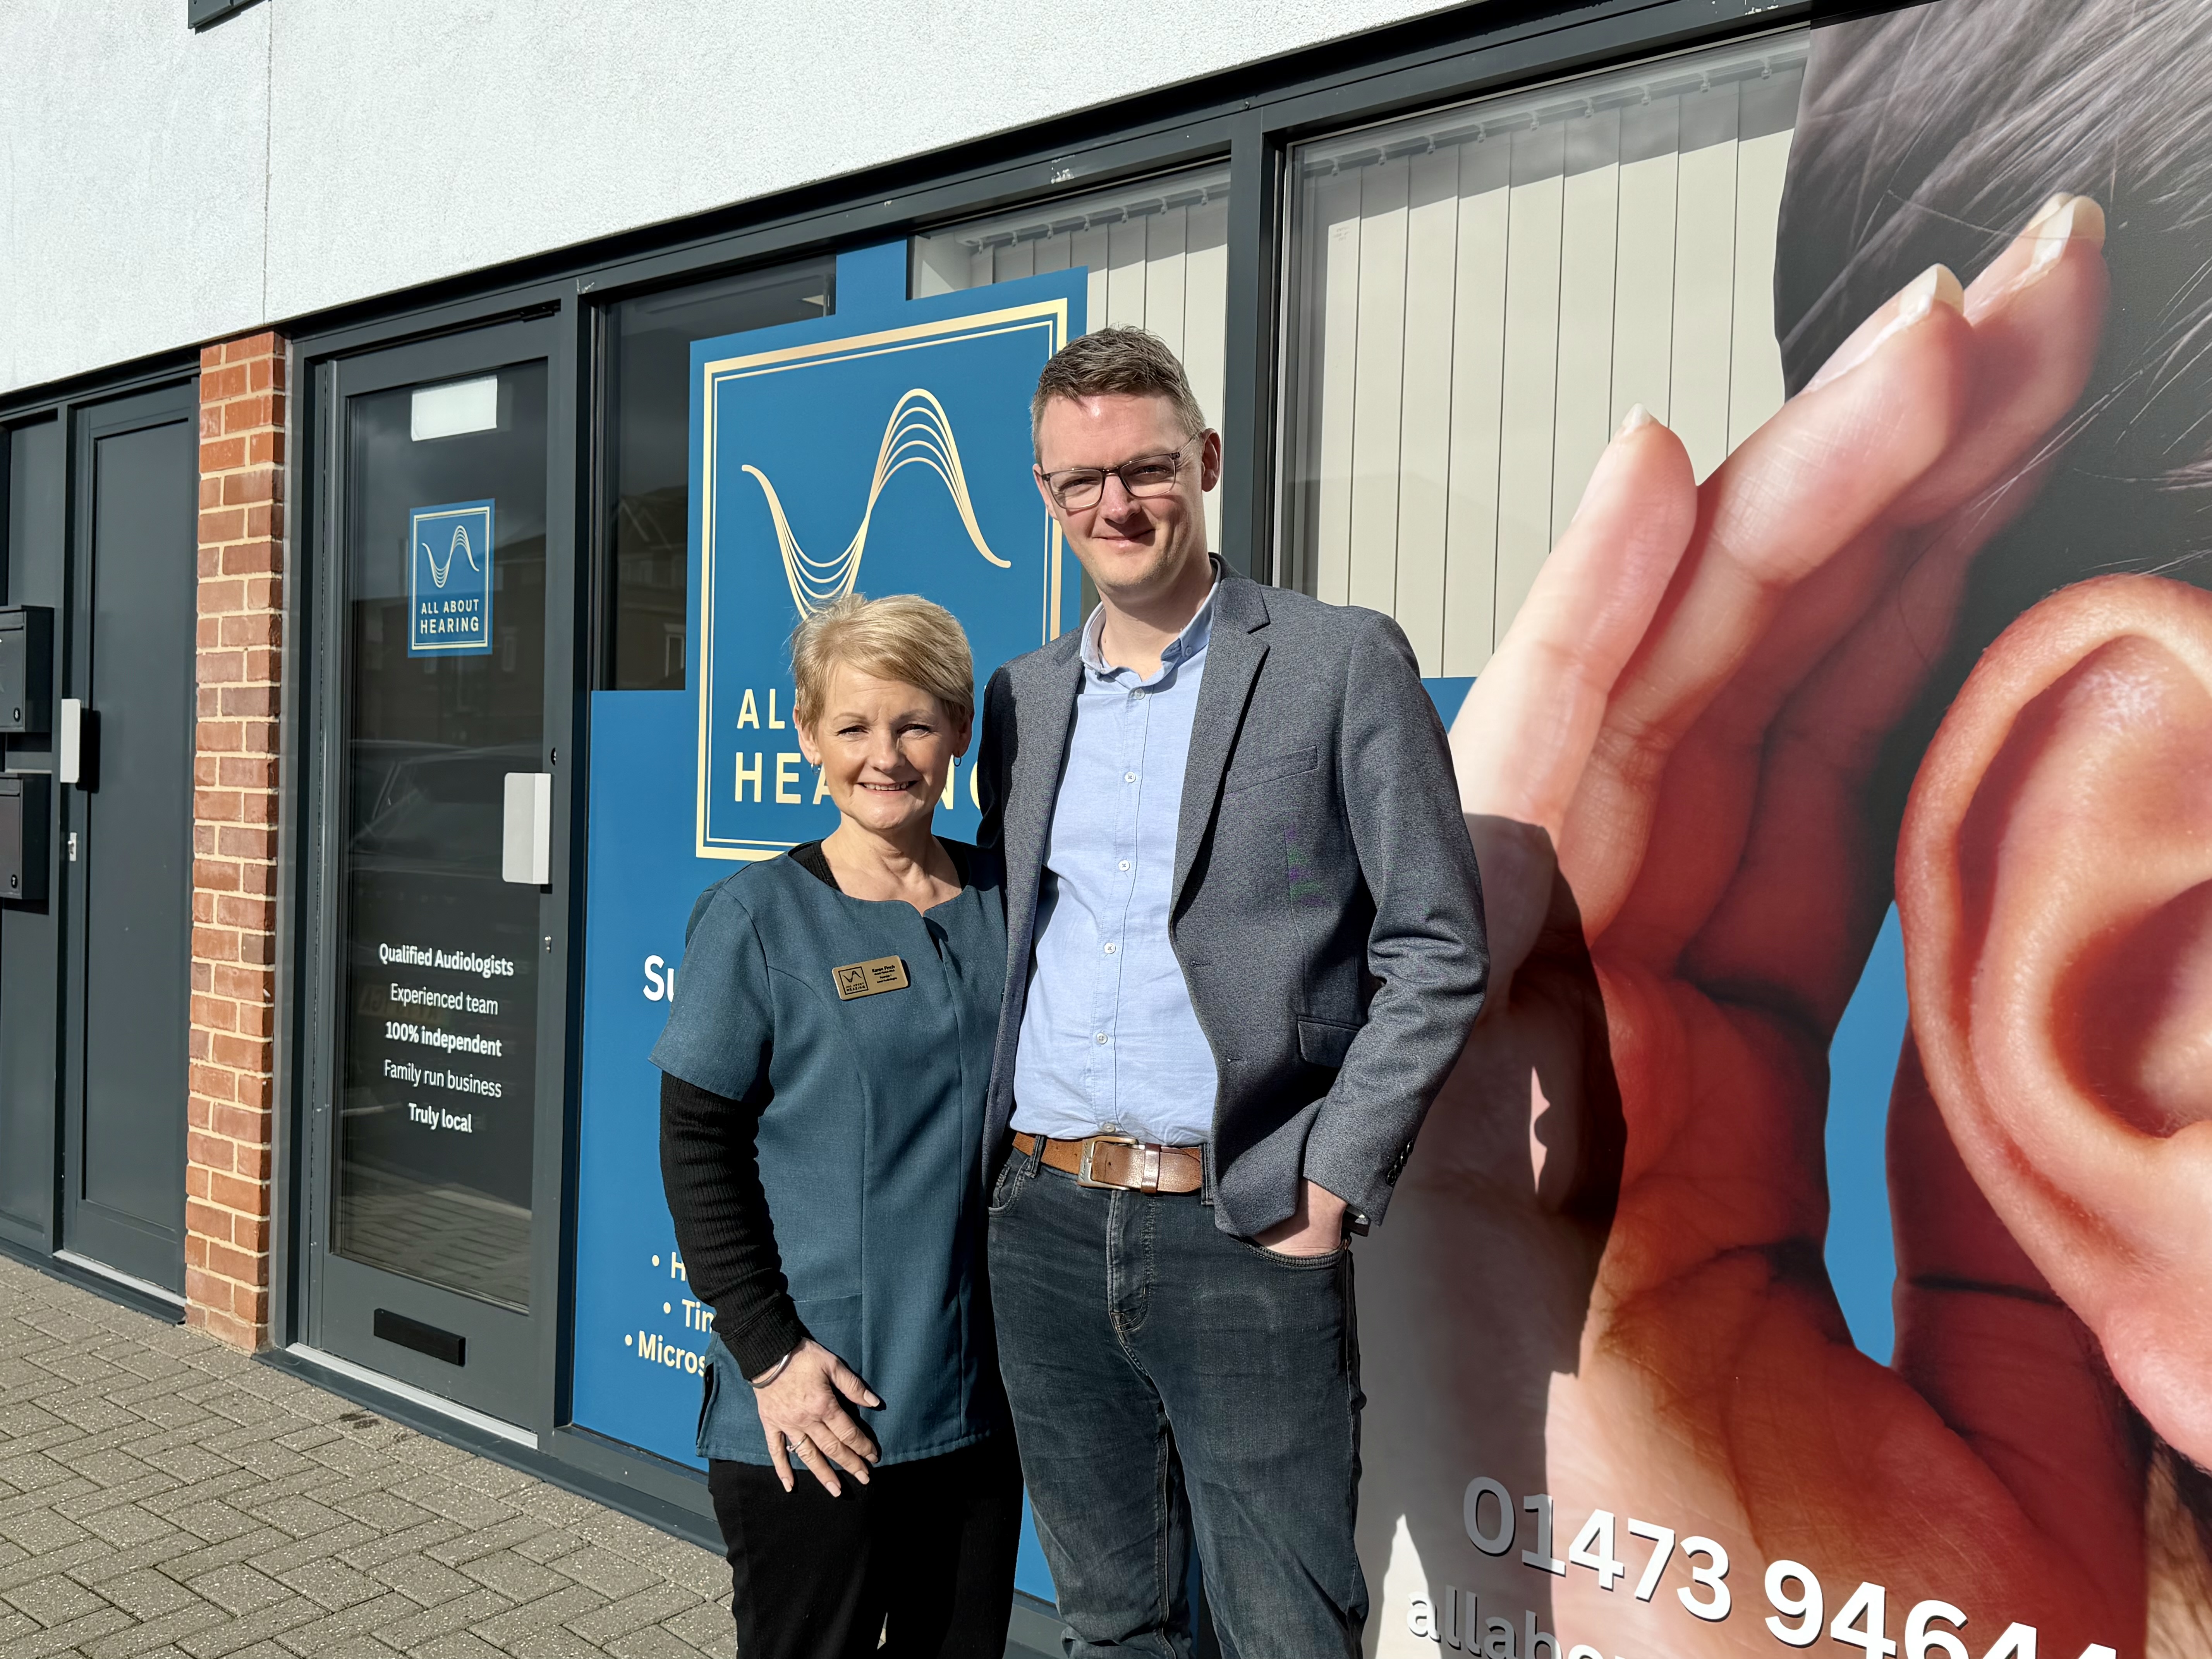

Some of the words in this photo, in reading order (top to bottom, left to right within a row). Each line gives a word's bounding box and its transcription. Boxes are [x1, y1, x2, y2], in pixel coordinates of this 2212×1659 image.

[421, 602, 438, 615] ALL
[443, 599, 479, 613] ABOUT
[420, 617, 479, 634] HEARING
[737, 689, 799, 729] AL
[379, 943, 432, 967] Qualified
[434, 950, 514, 979] Audiologists
[391, 983, 463, 1010] Experienced
[465, 994, 498, 1015] team
[385, 1022, 419, 1043] 100%
[421, 1026, 502, 1057] independent
[384, 1059, 421, 1087] Family
[424, 1070, 444, 1087] run
[447, 1070, 502, 1098] business
[409, 1103, 440, 1130] Truly
[441, 1108, 472, 1133] local
[1463, 1476, 1732, 1623] 01473
[1406, 1585, 1629, 1659] allab
